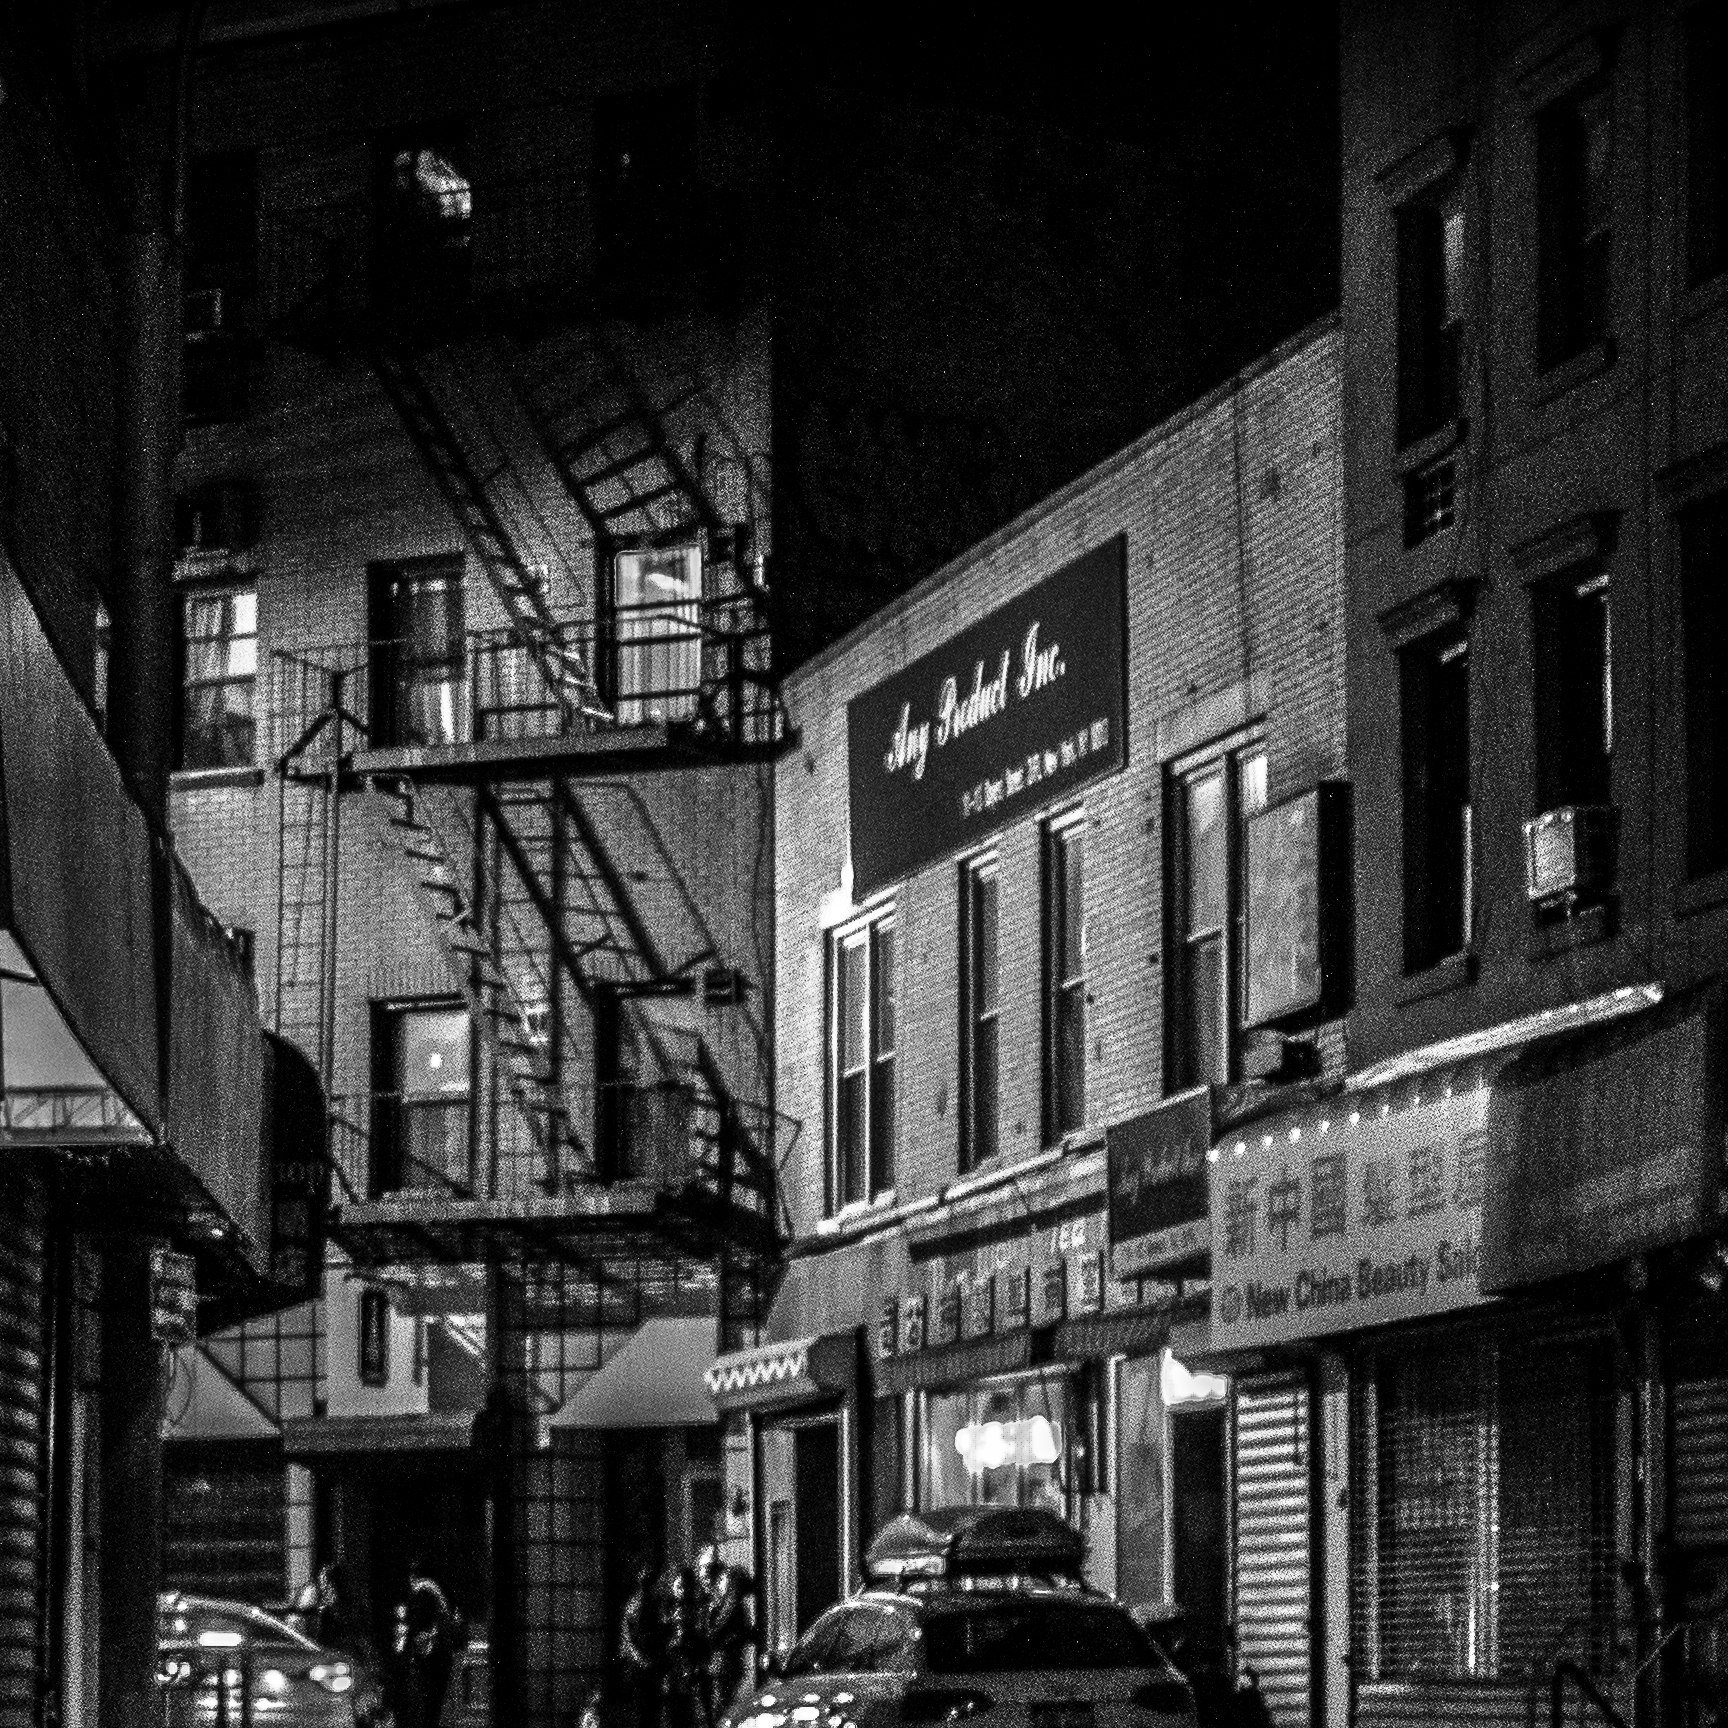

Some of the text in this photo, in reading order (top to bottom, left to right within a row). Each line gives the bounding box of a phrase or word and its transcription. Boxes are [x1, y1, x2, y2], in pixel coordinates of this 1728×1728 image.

[1245, 1280, 1290, 1320] New
[1295, 1266, 1352, 1310] China
[1356, 1253, 1431, 1299] Beauty
